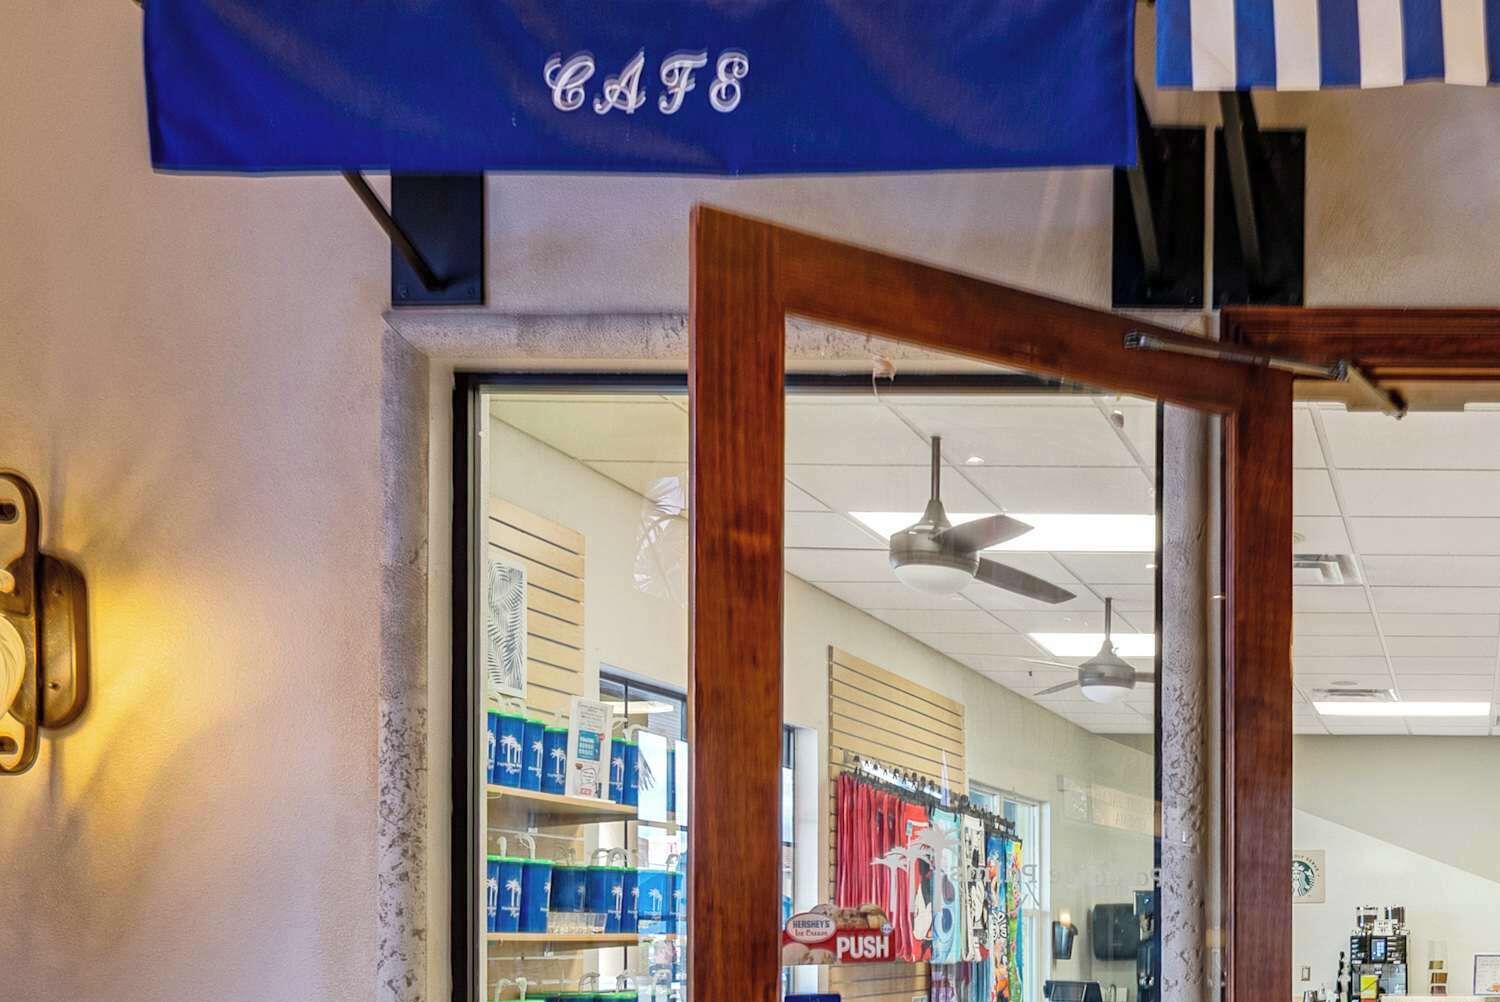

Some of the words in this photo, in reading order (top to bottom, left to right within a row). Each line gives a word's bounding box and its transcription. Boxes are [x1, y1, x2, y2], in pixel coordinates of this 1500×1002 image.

[543, 48, 750, 115] CAFE
[792, 920, 830, 929] HERSHEY'S
[836, 935, 889, 959] PUSH
